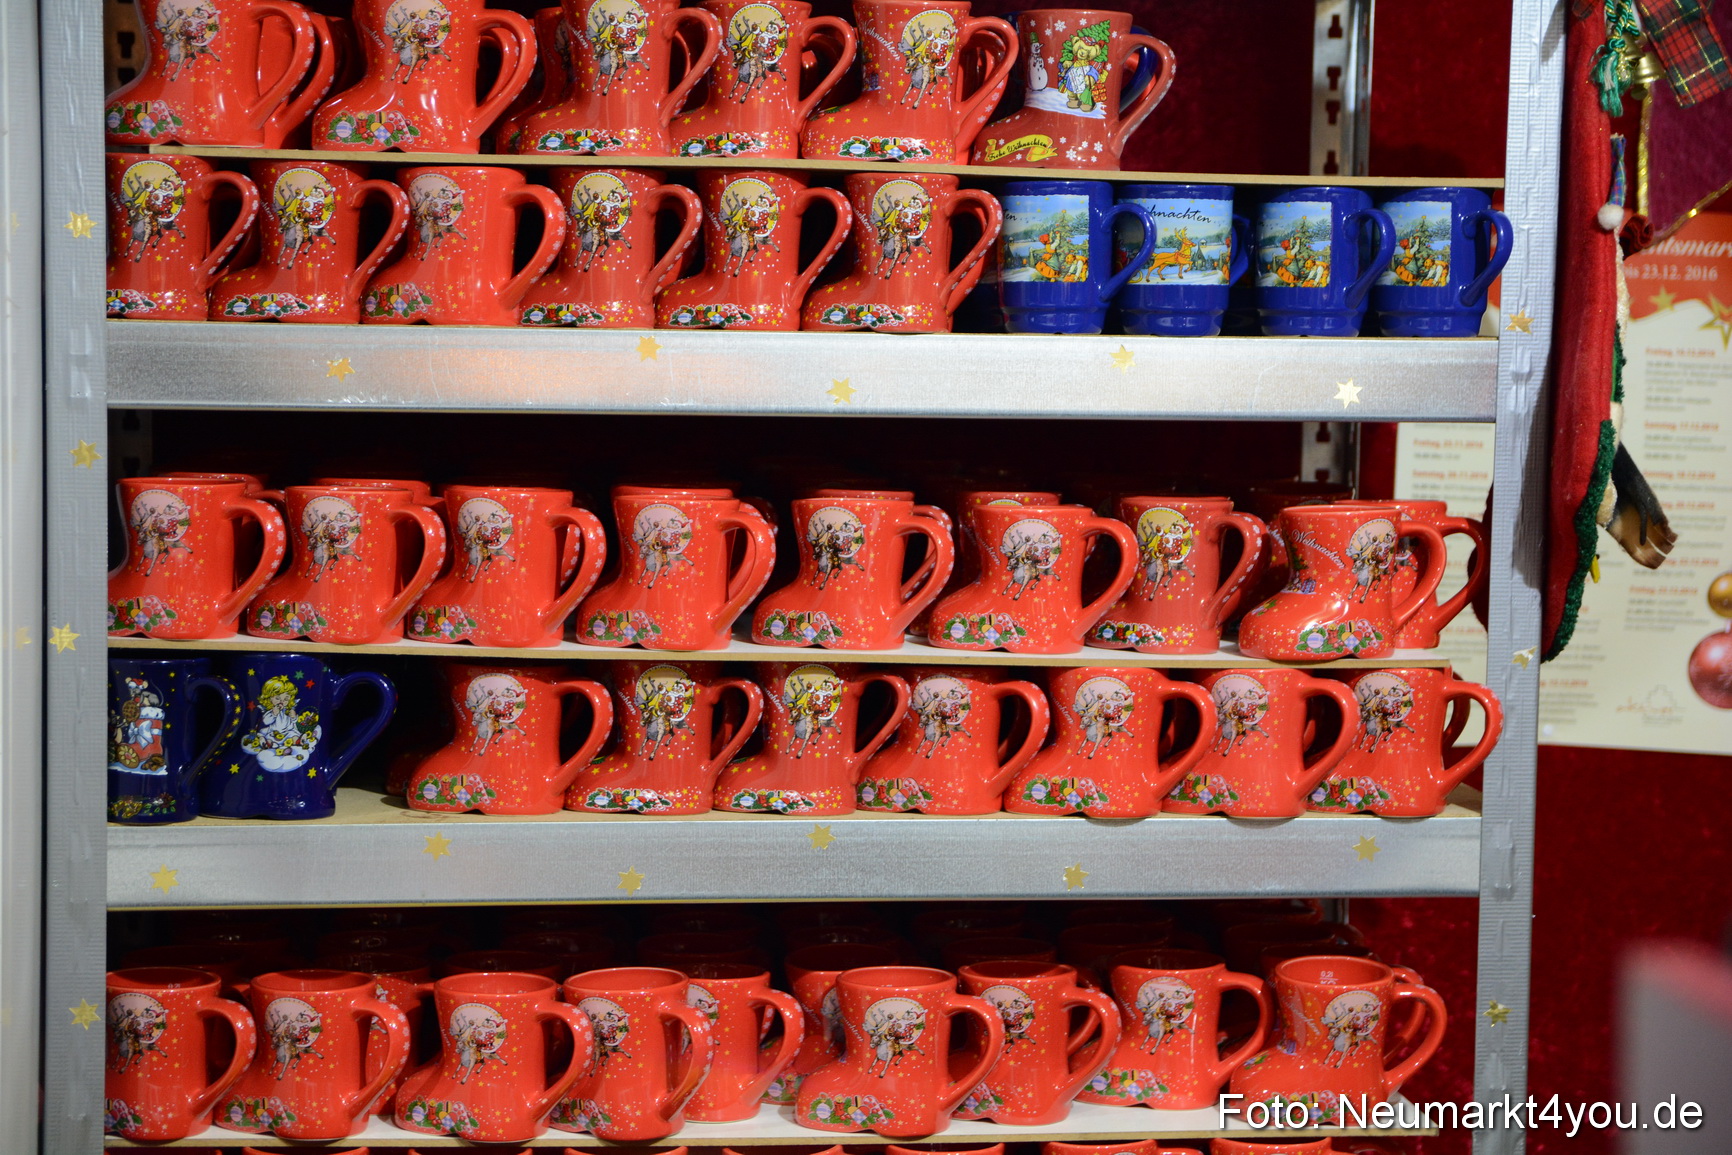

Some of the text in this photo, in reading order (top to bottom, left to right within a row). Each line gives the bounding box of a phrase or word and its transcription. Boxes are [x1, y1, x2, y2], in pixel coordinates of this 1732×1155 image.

[1148, 204, 1211, 224] hnachten
[1642, 263, 1681, 281] 23.12.
[1684, 264, 1719, 282] 2016
[1291, 529, 1346, 569] Weihnachten
